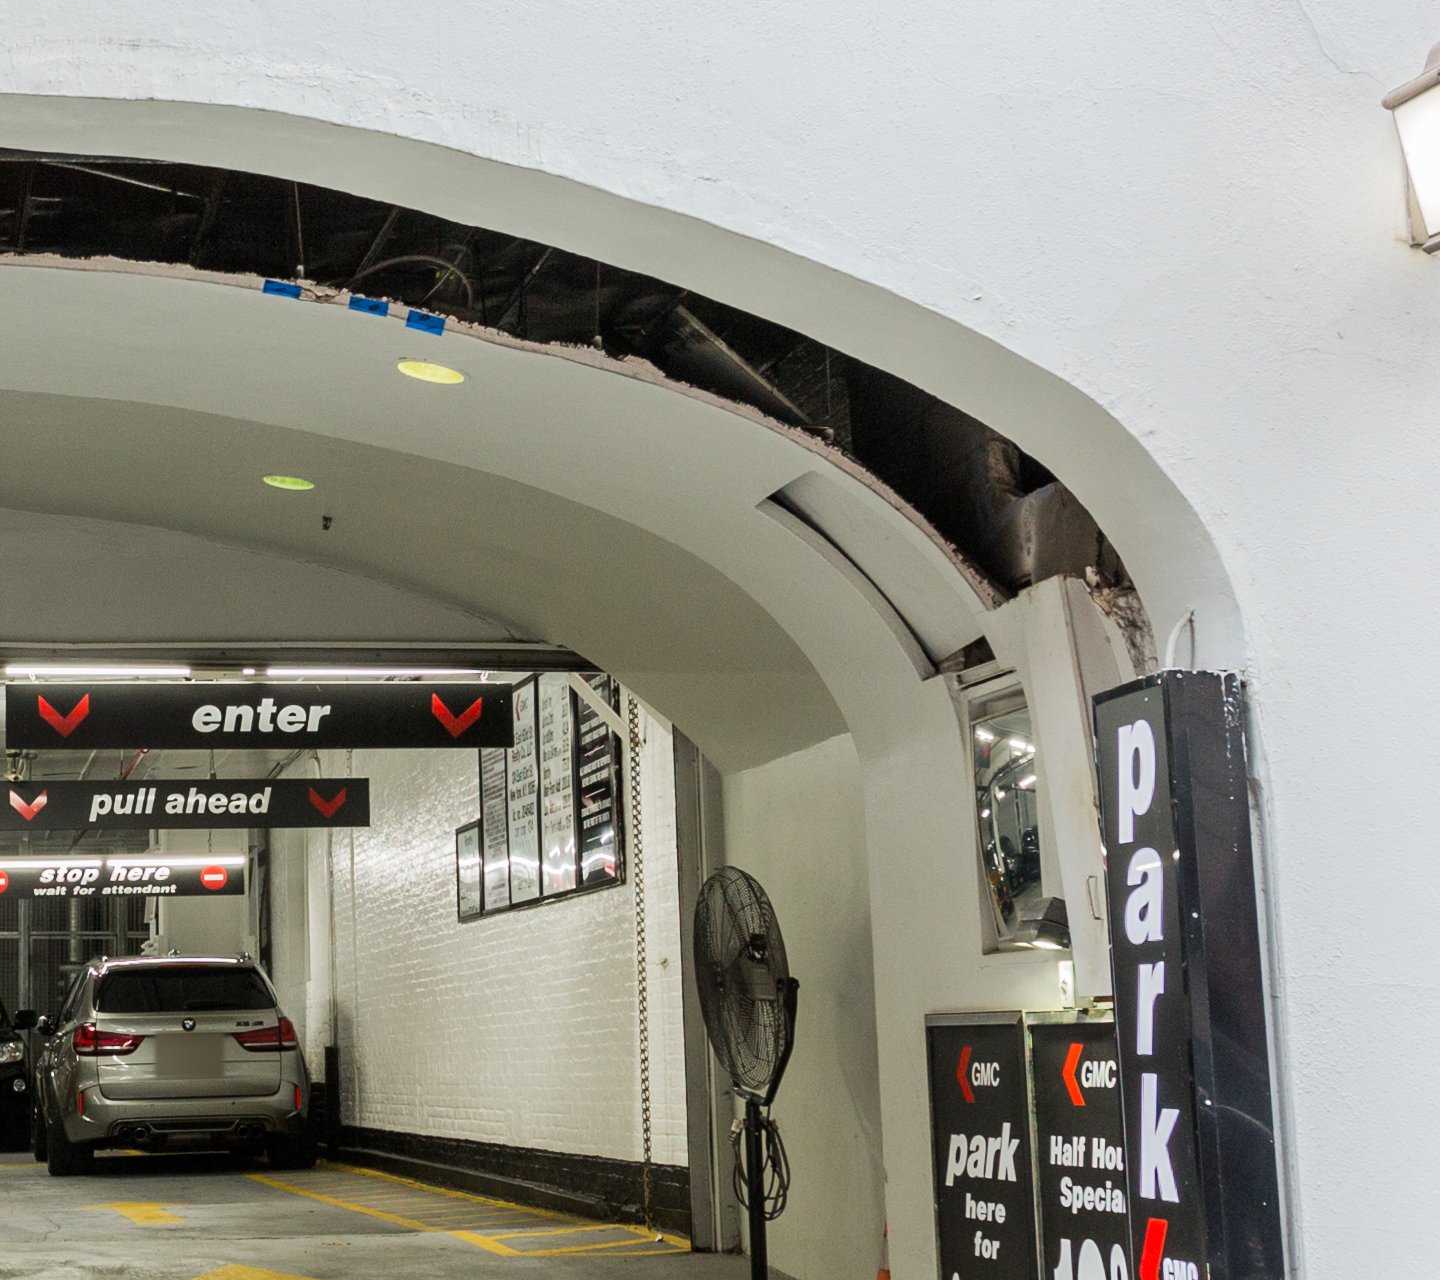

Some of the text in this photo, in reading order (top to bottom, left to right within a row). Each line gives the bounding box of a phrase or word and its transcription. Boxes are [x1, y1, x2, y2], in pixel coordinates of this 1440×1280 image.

[192, 698, 331, 732] enter
[89, 787, 272, 822] pull ahead
[33, 884, 176, 896] wait for attendant
[39, 866, 170, 883] stop here
[1118, 720, 1180, 1203] park
[971, 1062, 1000, 1088] GMC
[1081, 1060, 1117, 1089] GMC
[945, 1122, 1020, 1186] park
[1050, 1135, 1124, 1171] Half Hou
[965, 1193, 1006, 1224] here
[1060, 1176, 1126, 1215] Specia
[974, 1230, 1000, 1260] for
